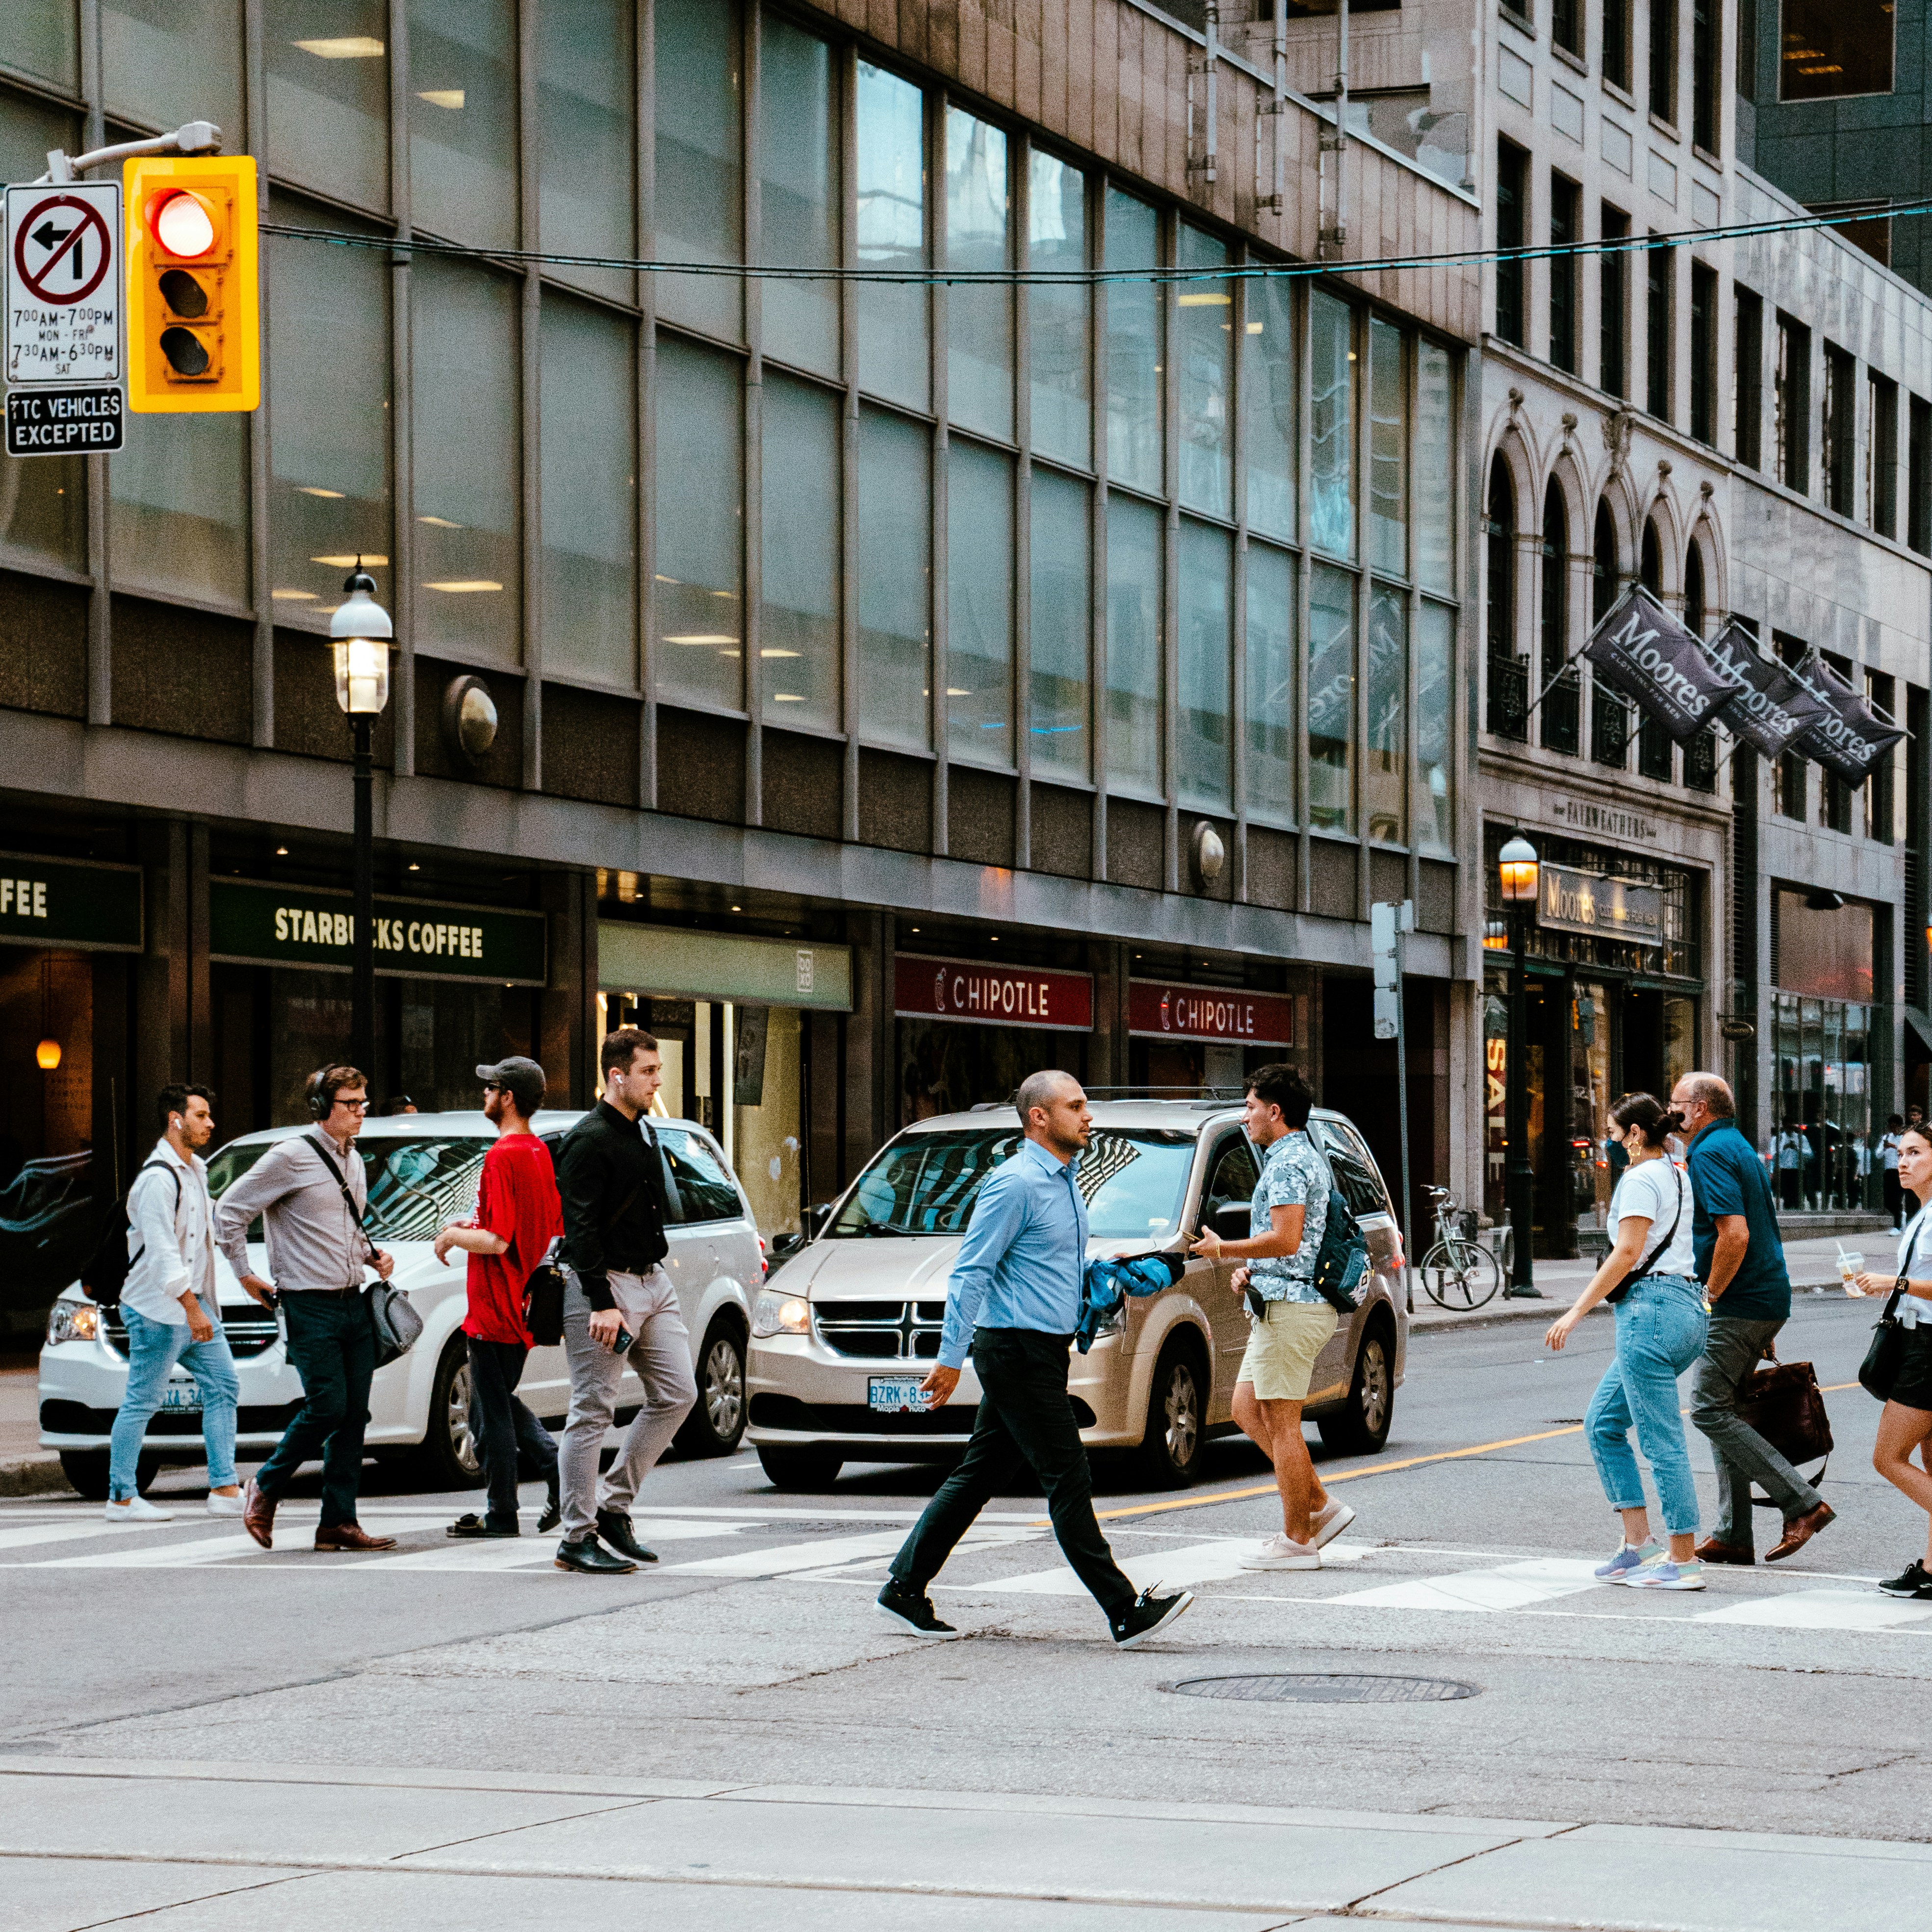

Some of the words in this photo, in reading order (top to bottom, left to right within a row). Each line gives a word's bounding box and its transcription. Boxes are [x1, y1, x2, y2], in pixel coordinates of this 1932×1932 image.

[39, 330, 59, 341] MON
[73, 329, 88, 340] FRI
[55, 363, 71, 375] SAT
[10, 399, 41, 419] TTC
[48, 395, 120, 418] VEHICLES
[16, 421, 115, 446] EXCEPTED
[1611, 611, 1710, 716] Moores
[1546, 873, 1595, 925] Moores
[275, 907, 404, 952] STARBKS
[408, 921, 483, 958] COFFEE
[953, 976, 1049, 1016] CHIPOTLE
[1177, 998, 1254, 1033] CHIPOTLE
[870, 1386, 901, 1404] BZRK
[877, 1405, 900, 1414] Maple
